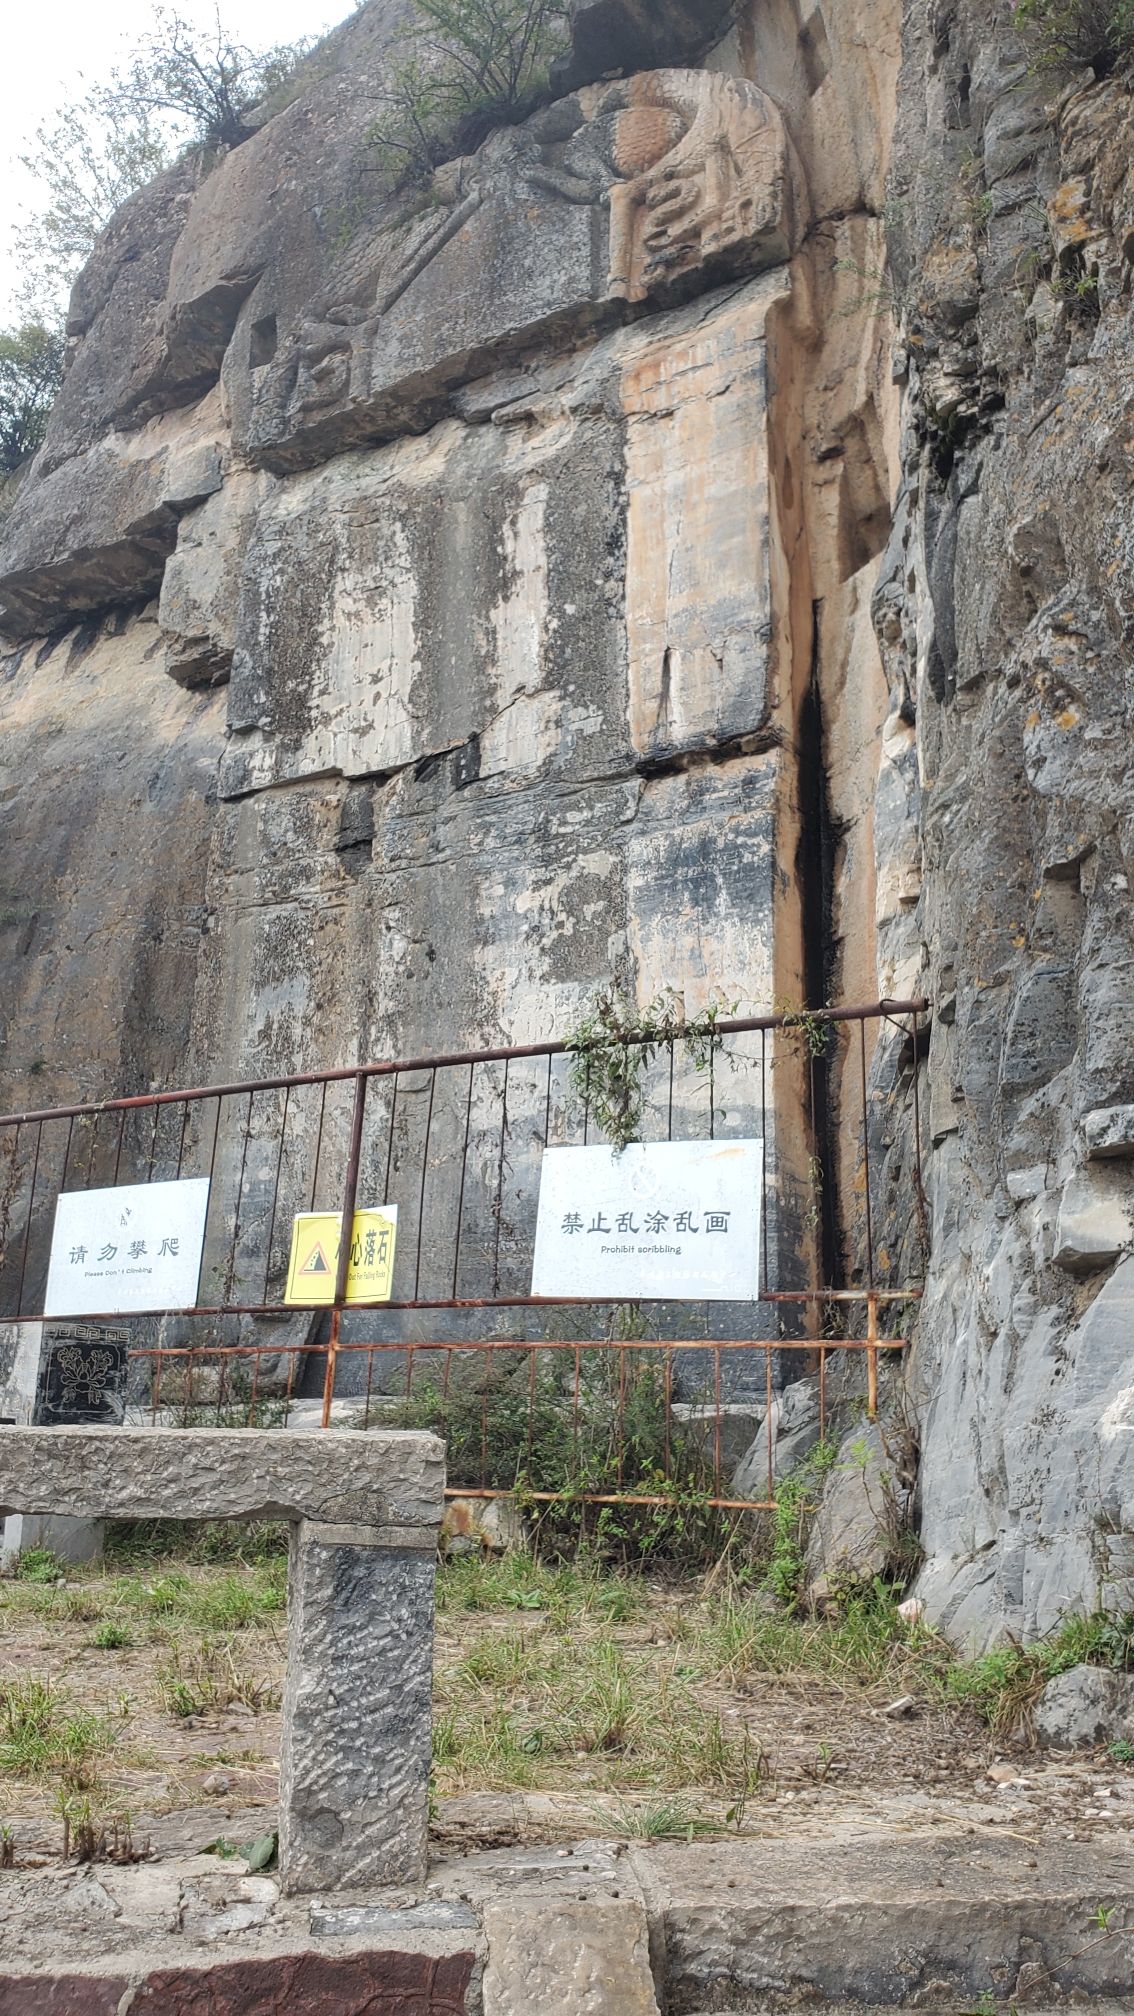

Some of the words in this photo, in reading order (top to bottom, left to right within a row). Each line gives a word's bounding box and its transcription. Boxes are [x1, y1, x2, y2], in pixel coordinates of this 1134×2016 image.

[561, 1210, 731, 1234] 禁止乱涂乱画
[69, 1238, 180, 1264] 请勿攀爬
[335, 1229, 390, 1267] 心落石
[601, 1245, 635, 1254] Prohibit
[637, 1245, 682, 1256] scribbling
